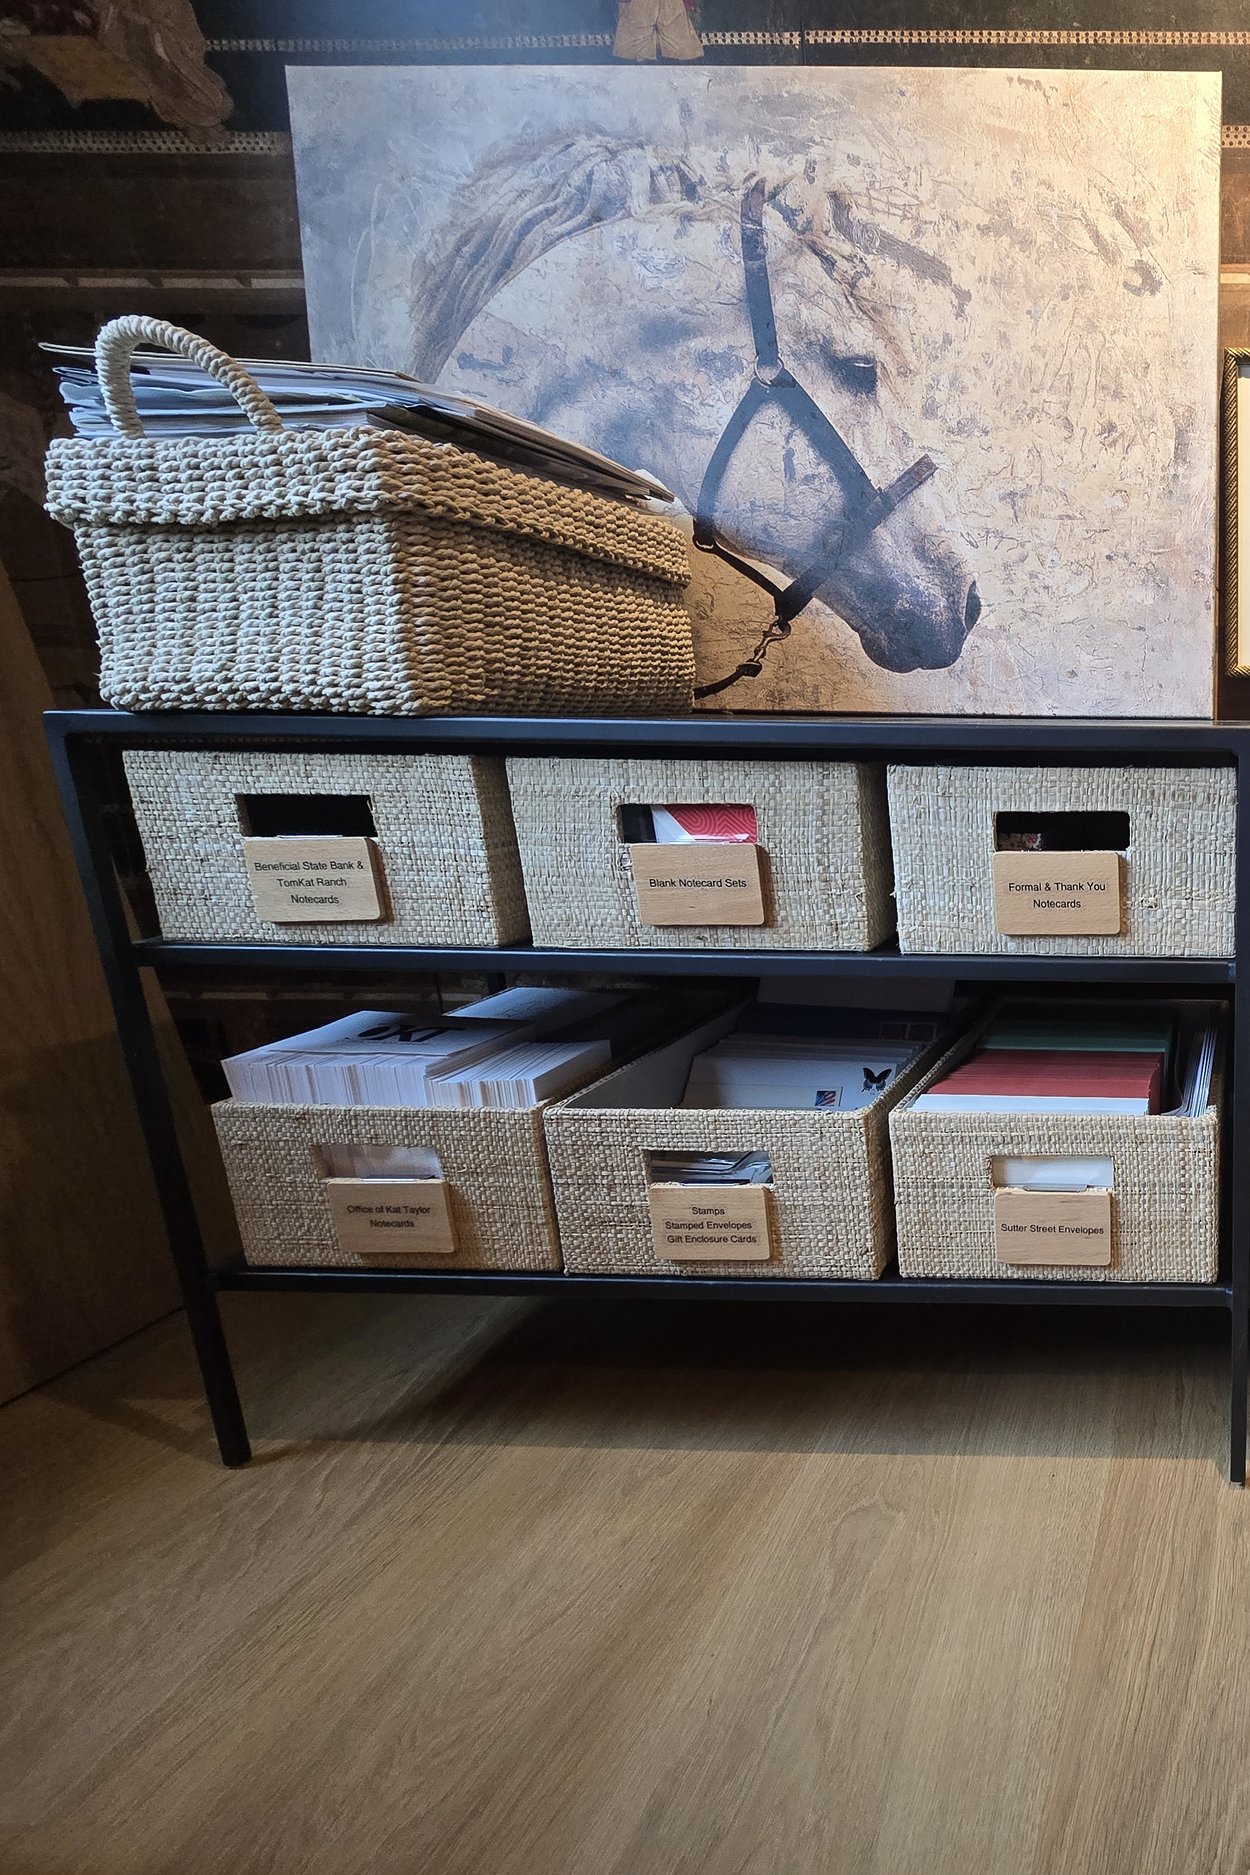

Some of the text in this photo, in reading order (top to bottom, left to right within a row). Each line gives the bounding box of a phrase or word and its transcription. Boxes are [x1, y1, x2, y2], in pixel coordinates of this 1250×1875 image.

[254, 861, 363, 871] Beneficial State Bank &
[277, 878, 347, 888] TomKat Ranch
[649, 879, 747, 887] Blank Notecard Sets
[1009, 882, 1106, 891] Formal & Thank You
[291, 895, 339, 904] Notecards
[1033, 900, 1081, 908] Notecards
[347, 1206, 373, 1214] Office
[403, 1206, 430, 1215] Taylor
[692, 1207, 725, 1216] Stamps
[370, 1220, 415, 1228] Notecards
[665, 1222, 752, 1230] Stamped Envelopes
[1001, 1224, 1104, 1235] Sutter Street Envelopes
